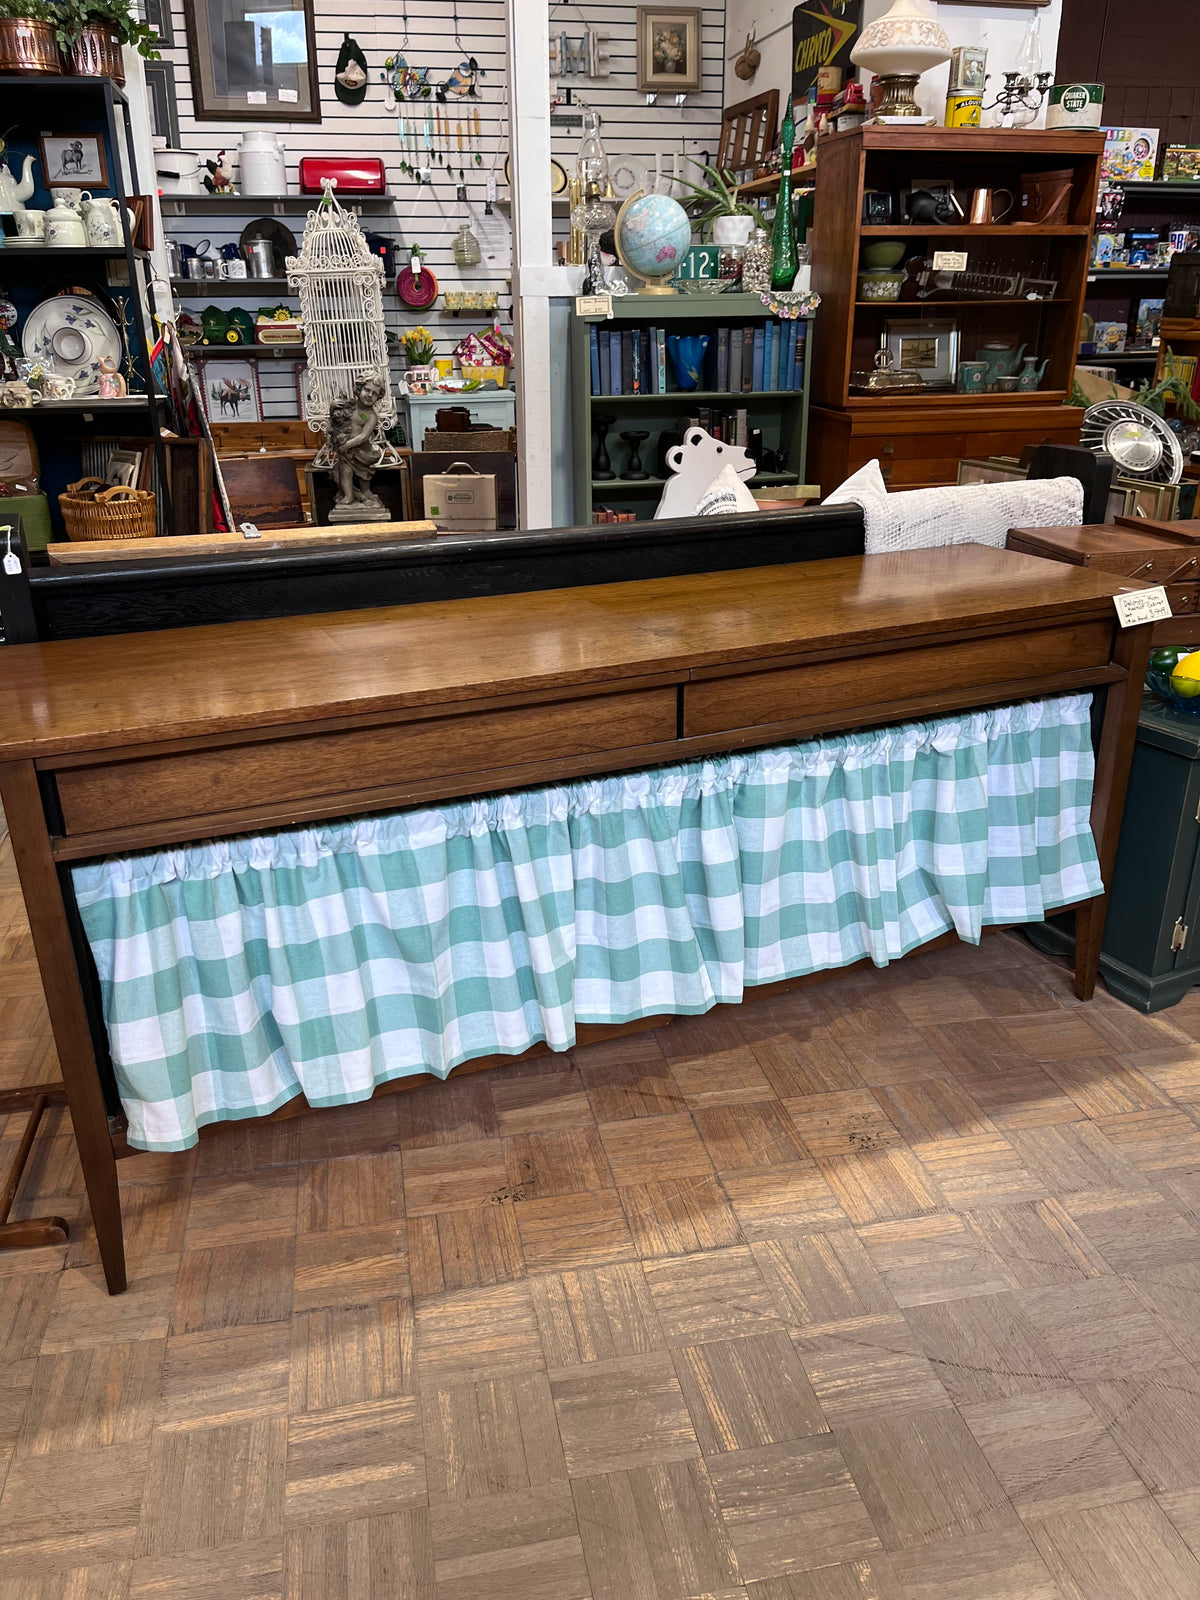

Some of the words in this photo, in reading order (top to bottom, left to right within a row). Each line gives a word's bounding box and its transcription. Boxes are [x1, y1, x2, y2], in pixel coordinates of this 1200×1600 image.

[795, 27, 832, 73] CHRYCO
[1065, 91, 1086, 99] QUAKER
[1066, 100, 1084, 108] STATE
[1106, 129, 1132, 141] LIFE
